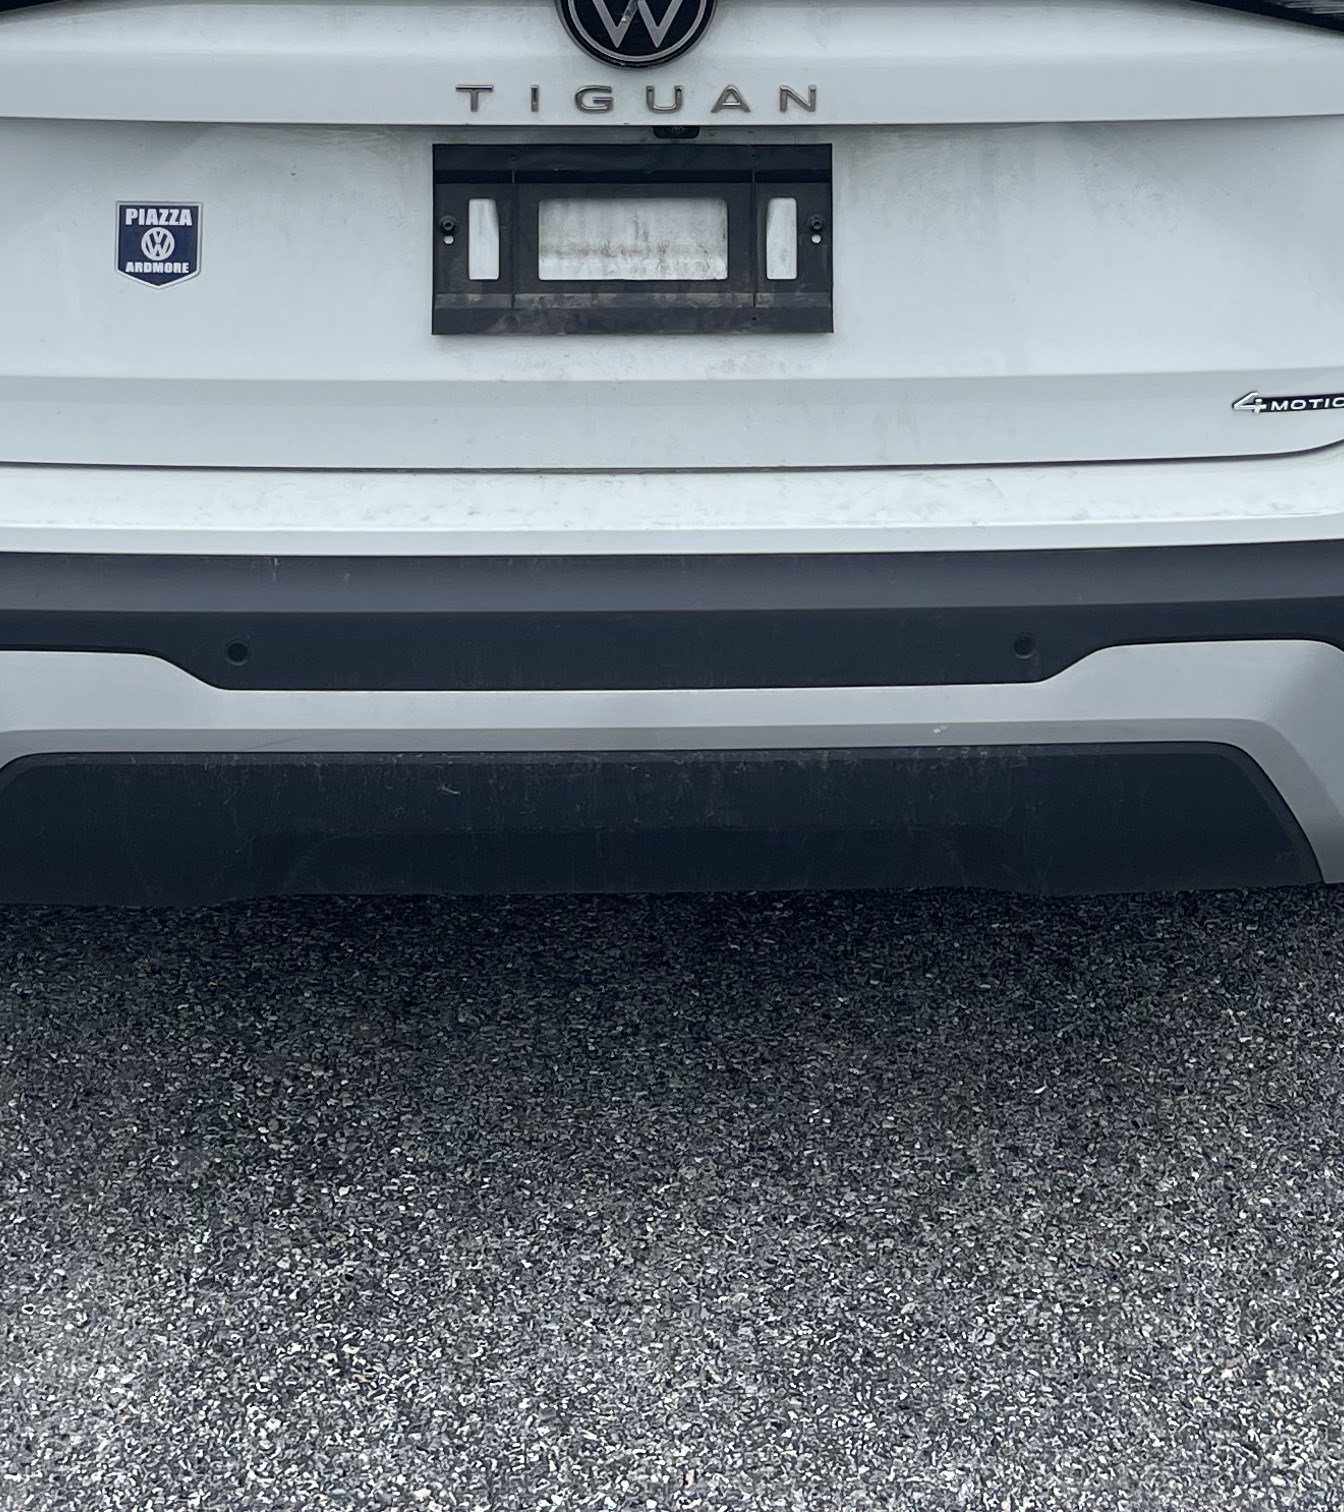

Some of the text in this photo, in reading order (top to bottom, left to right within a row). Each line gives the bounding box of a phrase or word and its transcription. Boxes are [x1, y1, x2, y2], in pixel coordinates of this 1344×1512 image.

[456, 85, 819, 114] TIGUAN
[125, 208, 193, 226] PIAZZA
[125, 261, 190, 273] ARDMORE
